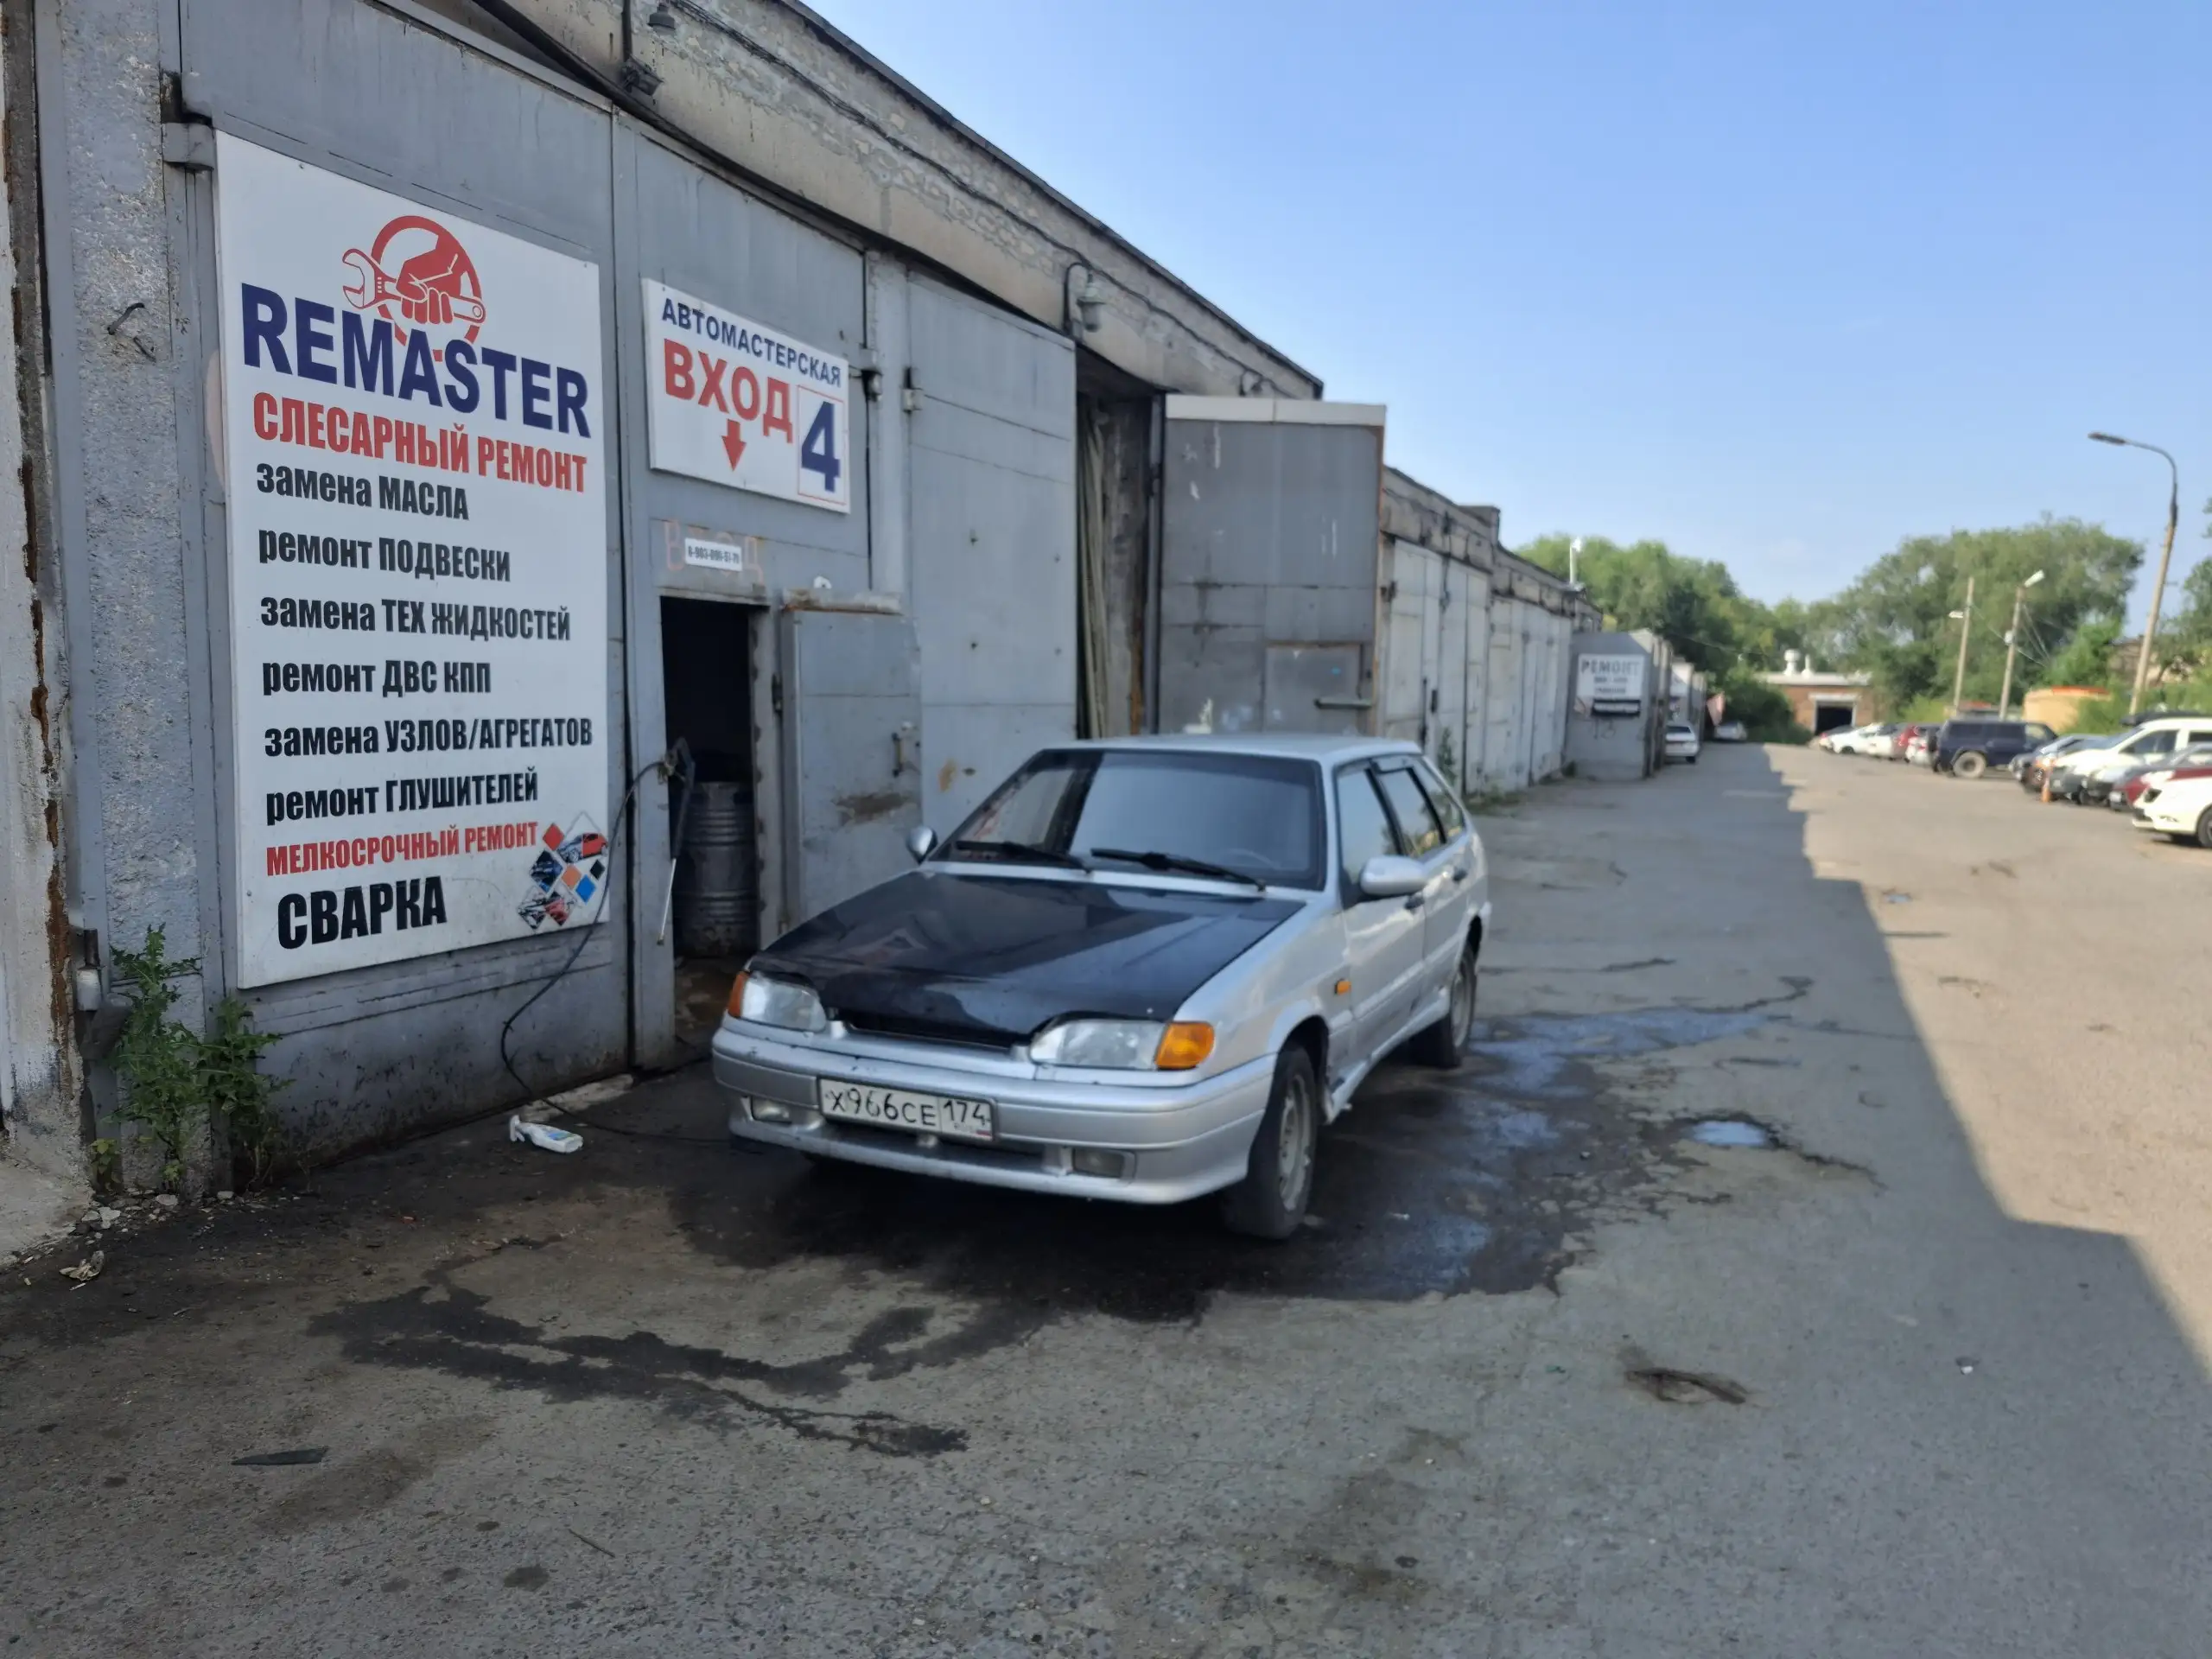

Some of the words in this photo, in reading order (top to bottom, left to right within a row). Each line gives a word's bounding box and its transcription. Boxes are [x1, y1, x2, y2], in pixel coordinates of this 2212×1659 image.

[241, 283, 591, 439] REMASTER
[662, 298, 842, 388] АВТОМАСТЕРСКАЯ
[664, 338, 793, 444] ВХОД
[253, 391, 470, 474] СЛЕСАРНЫЙ
[478, 435, 588, 493] РЕМОНТ
[801, 400, 841, 493] 4
[257, 462, 372, 507] замена
[378, 475, 470, 521] МАСЛА
[258, 529, 372, 569] ремонт
[378, 537, 512, 582] ПОДВЕСКИ
[260, 596, 376, 632] замена
[381, 599, 427, 634] ТЕХ
[432, 602, 571, 641] ЖИДКОСТЕЙ
[262, 661, 376, 696] ремонт
[382, 660, 437, 698] ДВС
[444, 661, 492, 693] КПП
[264, 725, 379, 757] замена
[385, 717, 593, 753] УЗЛОВ/АГРЕГАТОВ
[266, 785, 379, 826] ремонт
[385, 766, 538, 812] ГЛУШИТЕЛЕЙ
[266, 823, 461, 876] МЕЛКОСРОЧНЫЙ
[465, 821, 538, 854] РЕМОНТ
[276, 875, 448, 950] СВАРКА
[944, 1099, 986, 1126] 174
